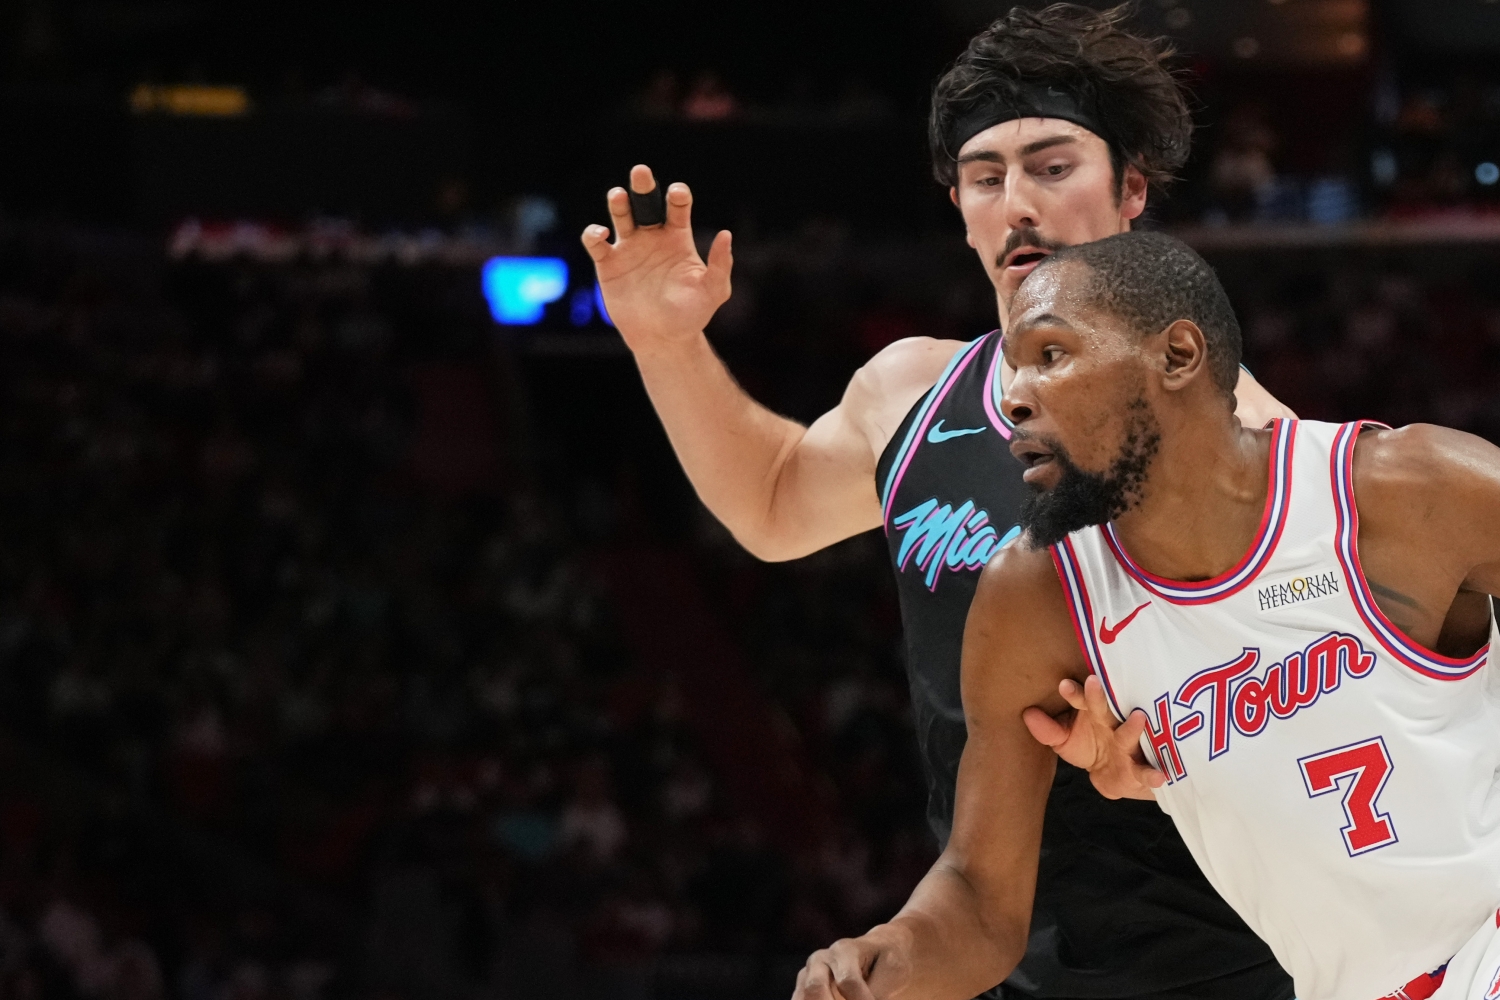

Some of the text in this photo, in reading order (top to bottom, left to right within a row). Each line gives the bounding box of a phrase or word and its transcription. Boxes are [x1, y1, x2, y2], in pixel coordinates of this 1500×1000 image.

[893, 497, 1022, 593] Mia
[1258, 571, 1339, 600] MEMORIAL
[1259, 580, 1339, 611] HERMANN
[1141, 631, 1377, 786] H-Town
[1296, 735, 1399, 858] 7
